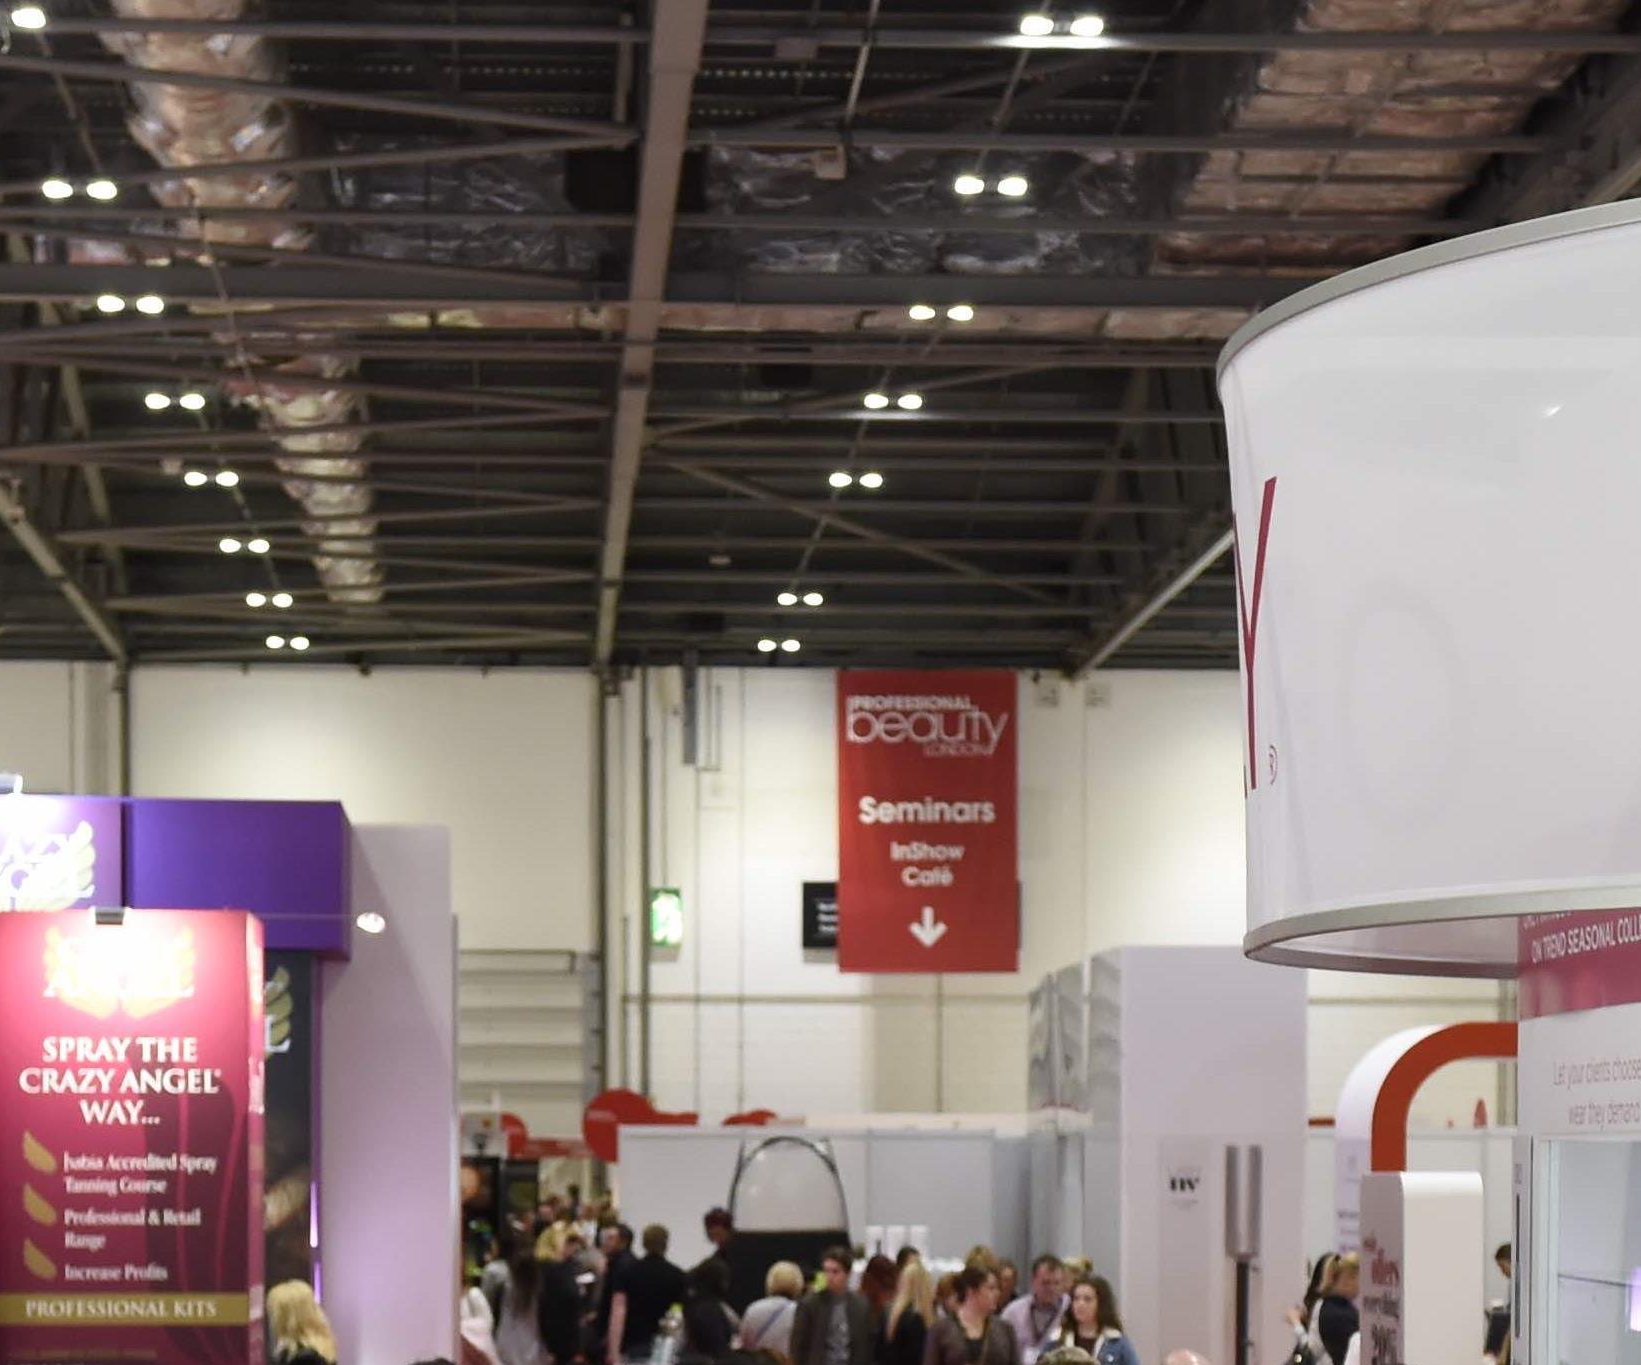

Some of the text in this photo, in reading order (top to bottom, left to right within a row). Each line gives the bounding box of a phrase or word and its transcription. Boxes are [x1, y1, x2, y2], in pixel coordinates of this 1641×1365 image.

[846, 697, 1009, 757] beauty
[859, 796, 996, 824] Seminars
[890, 841, 965, 862] InShow
[901, 866, 954, 887] Café
[1543, 931, 1568, 959] TREND
[1567, 920, 1616, 955] SEASONAL
[42, 1036, 199, 1064] SPRAY THE
[18, 1067, 117, 1095] CRAZY
[79, 1099, 161, 1126] WAY...
[106, 1152, 178, 1172] Accredited
[179, 1153, 218, 1175] Spray
[64, 1177, 168, 1196] Tanning Course
[64, 1208, 202, 1226] Professional & Retail
[64, 1233, 106, 1251] Range
[64, 1265, 168, 1281] Increase Profits
[25, 1299, 217, 1318] PROFESSIONAL KITS
